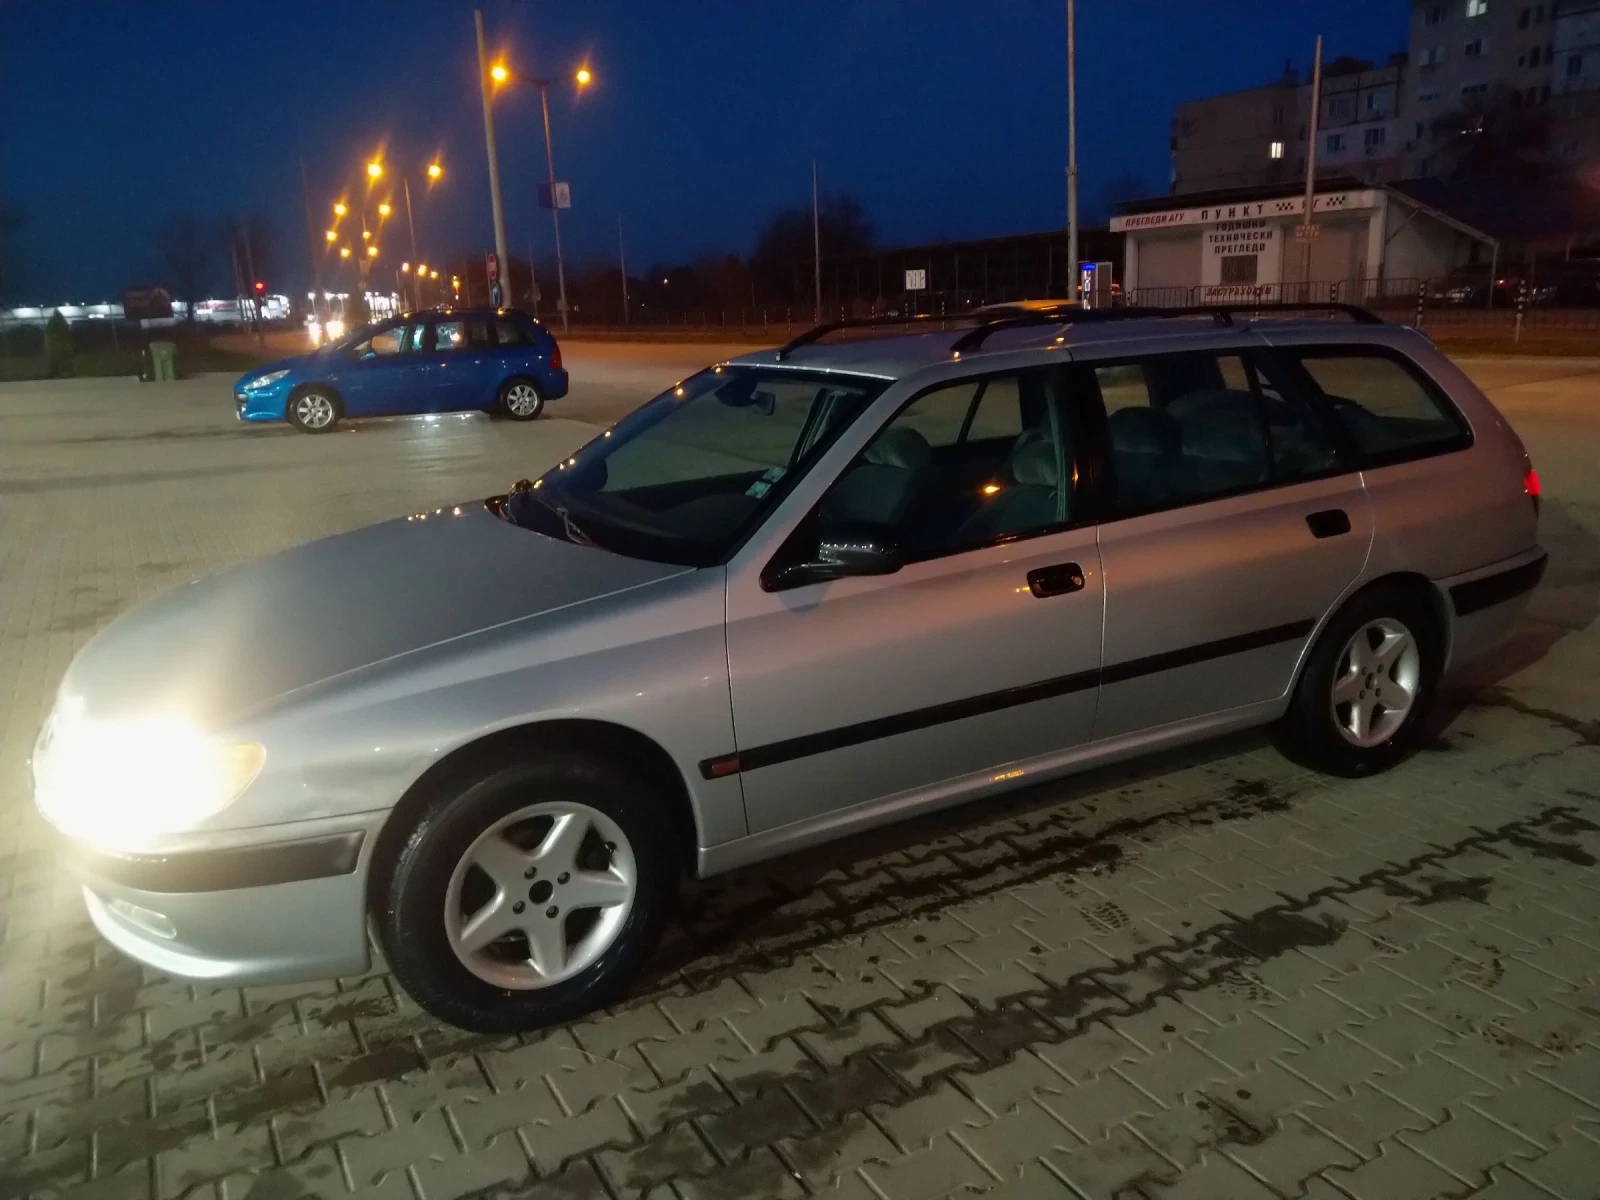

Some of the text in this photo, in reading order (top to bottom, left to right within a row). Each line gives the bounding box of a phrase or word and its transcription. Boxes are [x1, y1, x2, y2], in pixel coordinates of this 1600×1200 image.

[1201, 203, 1264, 220] ПУНКТ
[1125, 214, 1167, 226] ПРЕГЛЕДИ
[1215, 220, 1266, 231] ГОДИШНИ
[1209, 230, 1273, 243] ТЕХНИЧЕСКИ
[1214, 243, 1266, 254] ПРЕГЛЕДИ
